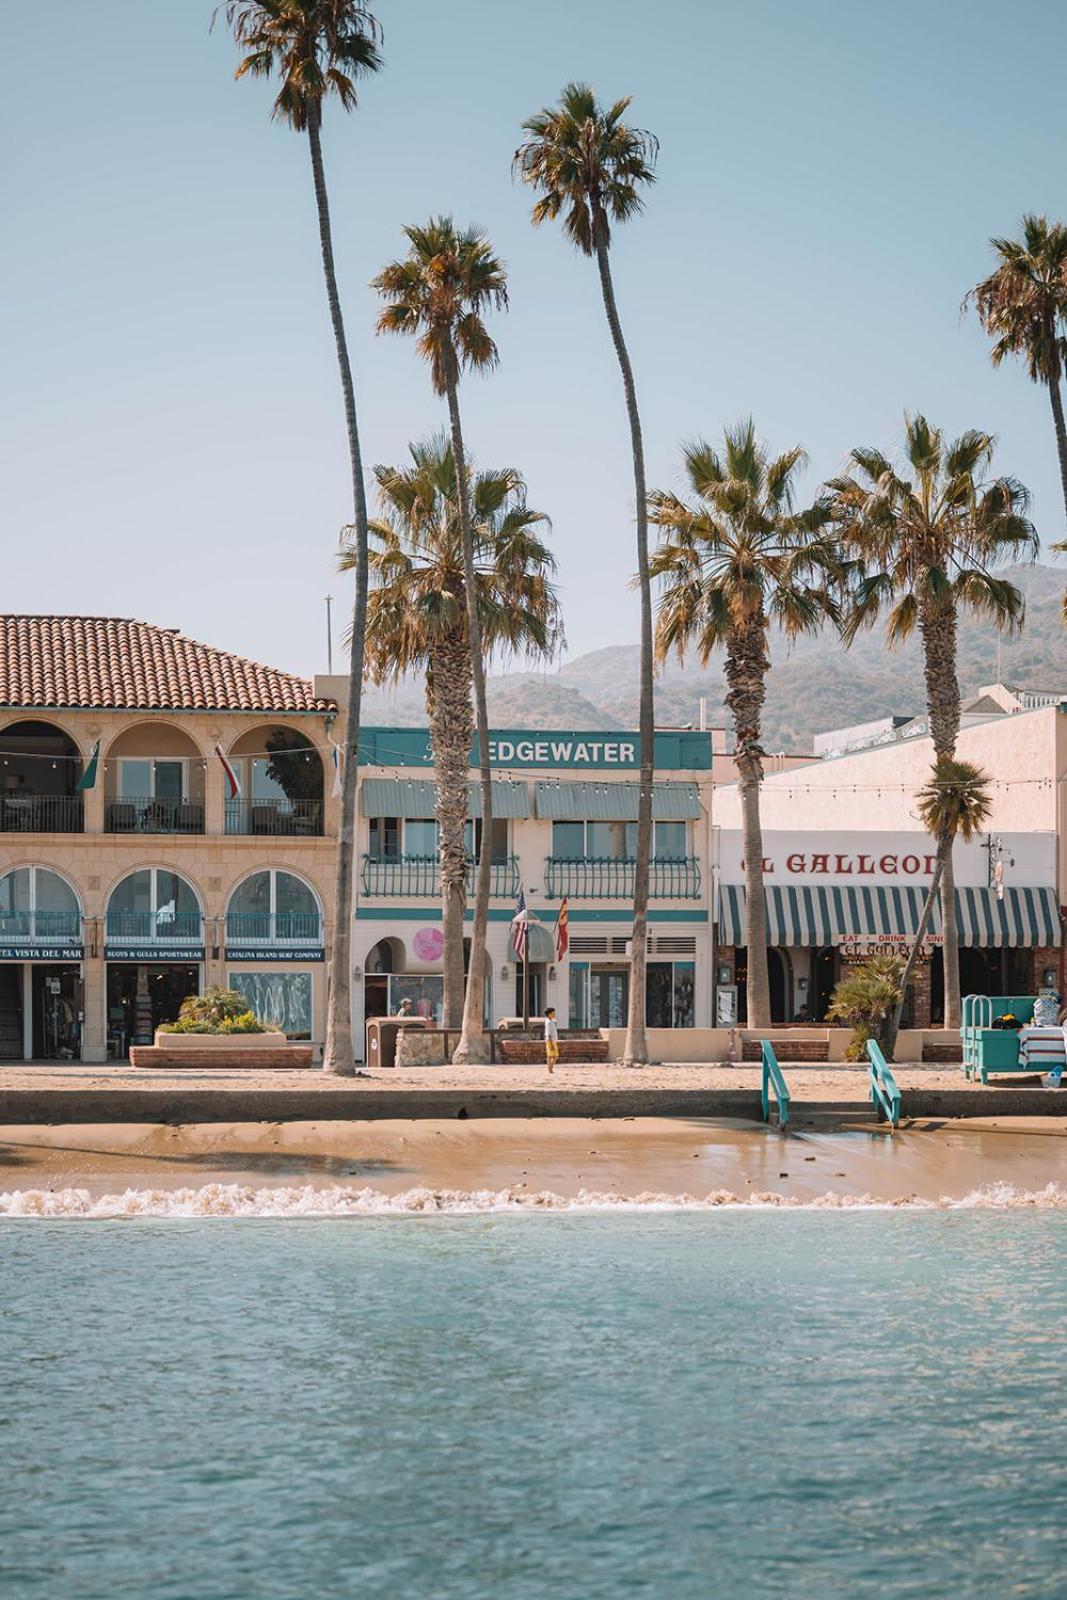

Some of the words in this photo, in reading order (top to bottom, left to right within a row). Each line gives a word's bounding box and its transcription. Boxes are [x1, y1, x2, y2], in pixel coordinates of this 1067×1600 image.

[489, 741, 635, 763] EDGEWATER
[741, 857, 775, 873] L
[15, 949, 40, 957] VISTA
[42, 949, 60, 957] DEL
[62, 949, 82, 957] MAR
[227, 951, 255, 959] CATALINA
[256, 951, 277, 959] ISLAND
[294, 951, 321, 959] COMPANY
